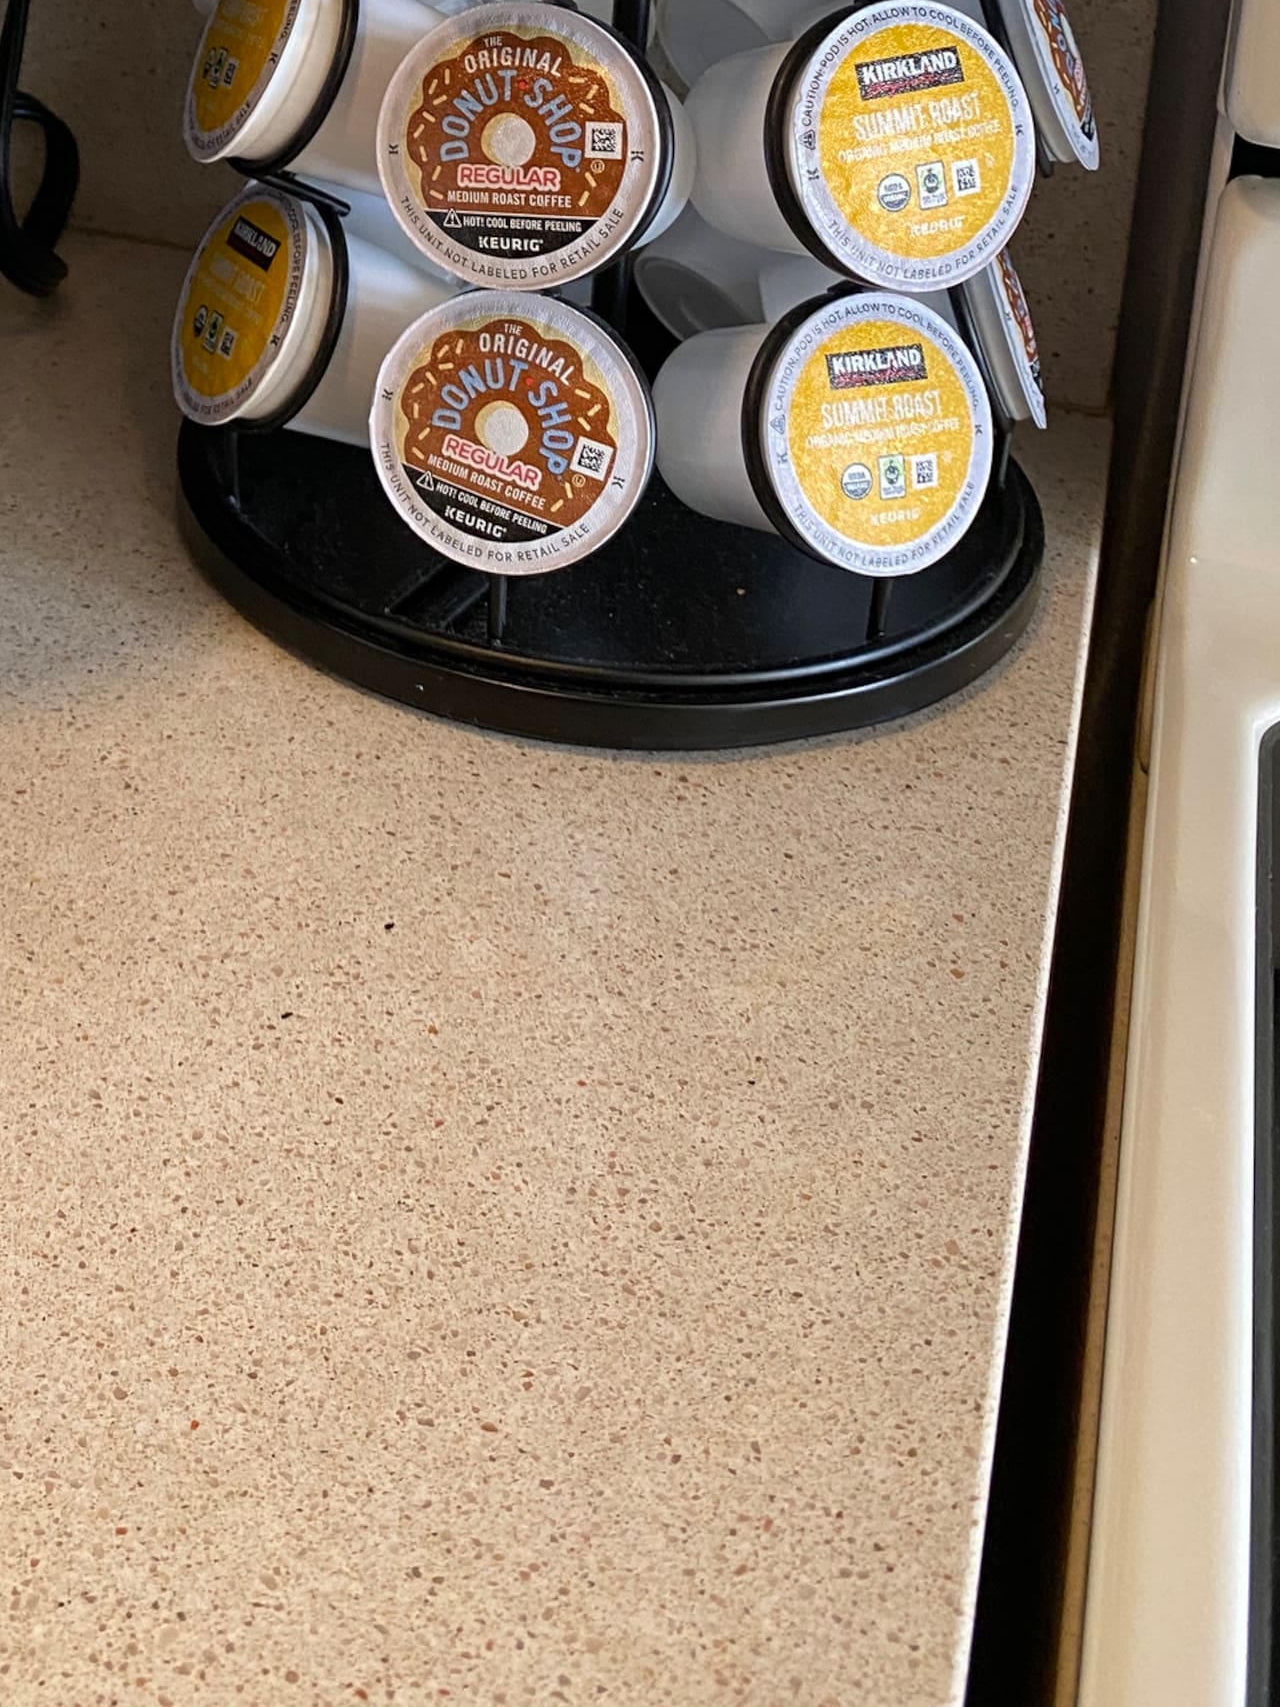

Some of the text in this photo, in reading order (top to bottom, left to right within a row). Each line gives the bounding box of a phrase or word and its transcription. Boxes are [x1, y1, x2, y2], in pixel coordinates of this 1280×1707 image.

[463, 46, 562, 77] ORIGINAL
[483, 36, 503, 49] THE
[862, 52, 957, 83] KIRKLAND
[441, 69, 583, 169] DONUT SHOP
[460, 165, 559, 189] REGULAR
[448, 191, 573, 208] MEDIUM ROAST COFFEE
[401, 196, 625, 280] THIS UNIT NOT LABELED FOR RETAIL SALE
[463, 216, 582, 233] HOT! COOL BEFORE PEELING
[505, 323, 524, 337] THE
[480, 334, 575, 387] ORIGINAL
[831, 349, 920, 372] KIRKLAND
[432, 359, 574, 475] DONUT SHOP
[427, 454, 547, 510] MEDIUM ROAST COFFEE
[443, 435, 540, 489] REGULAR
[381, 446, 590, 563] THIS UNIT NOT LABELED FOR RETAIL SALE
[436, 482, 549, 535] HOT! COOL BEFORE PEELING
